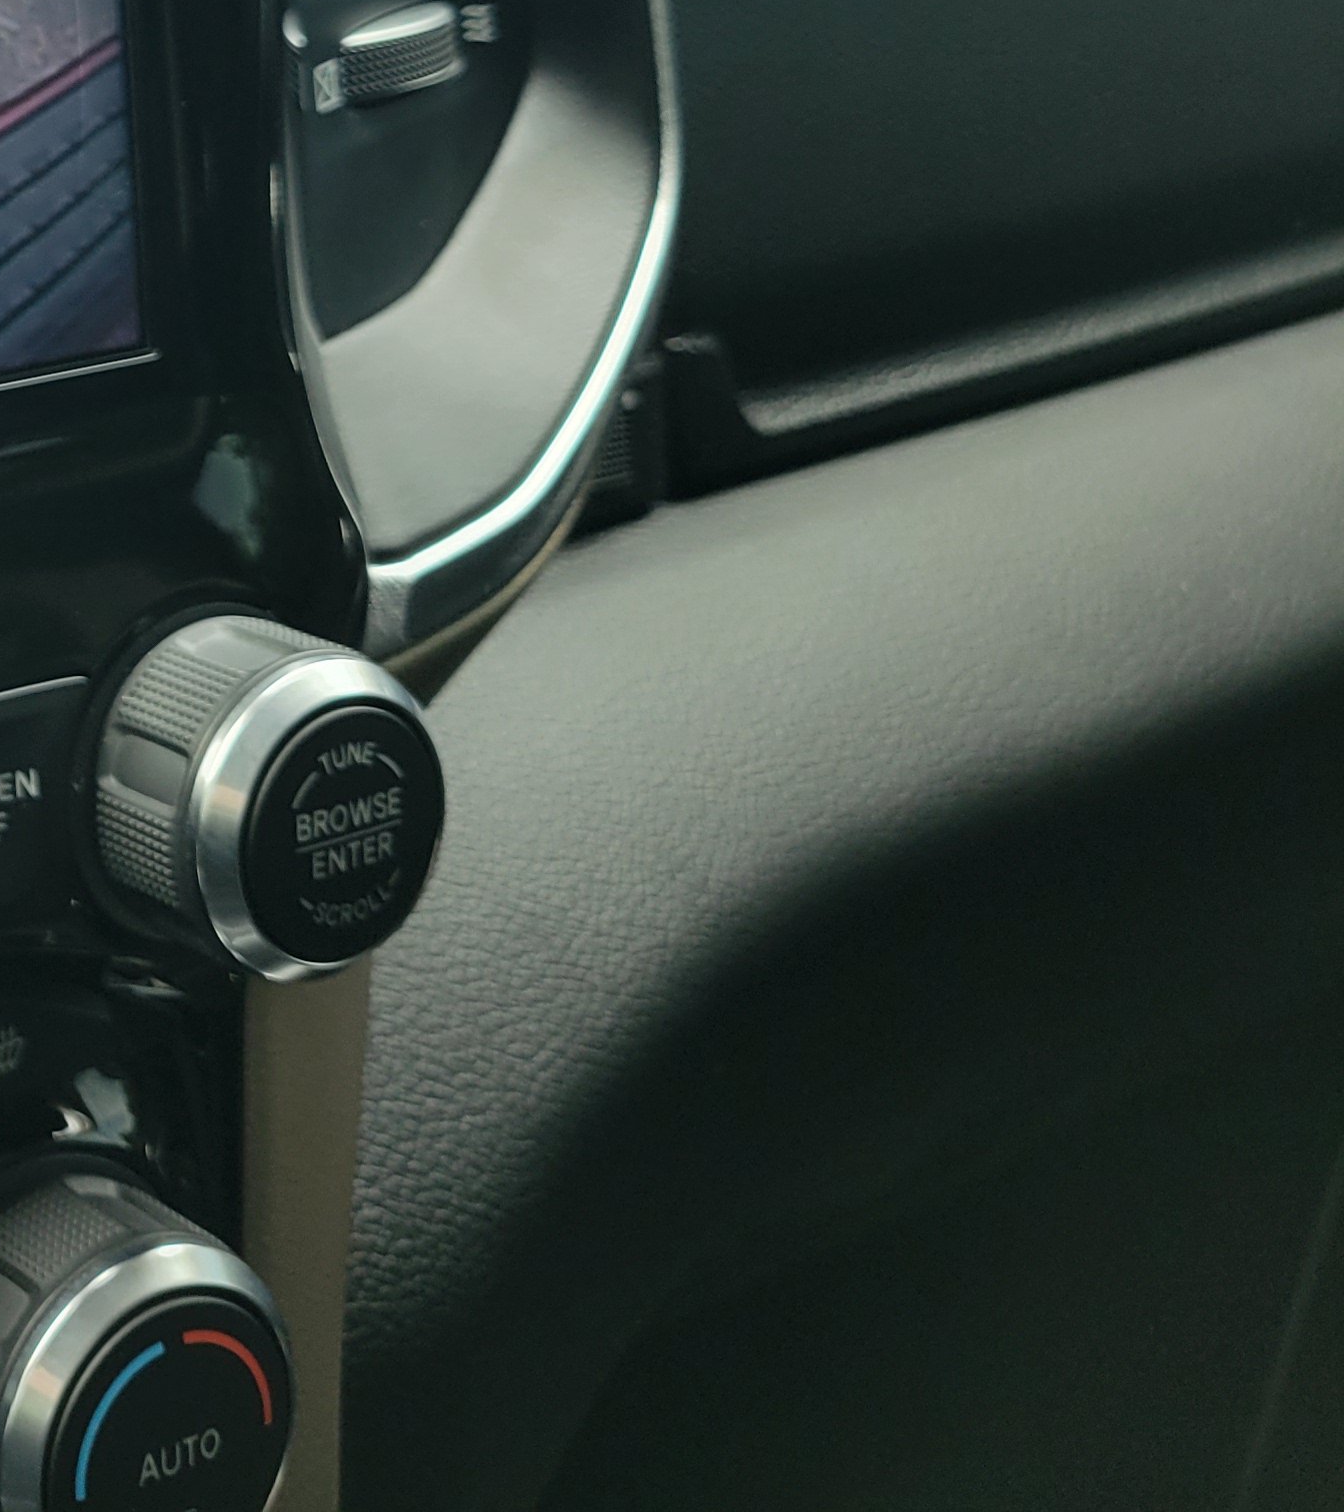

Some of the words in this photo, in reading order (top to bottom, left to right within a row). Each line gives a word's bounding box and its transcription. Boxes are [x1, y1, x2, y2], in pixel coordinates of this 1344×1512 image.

[319, 741, 378, 776] TUNE
[295, 787, 402, 844] BROWSE
[313, 832, 394, 880] ENTER
[313, 885, 391, 928] SCROLL
[139, 1426, 222, 1487] AUTO
